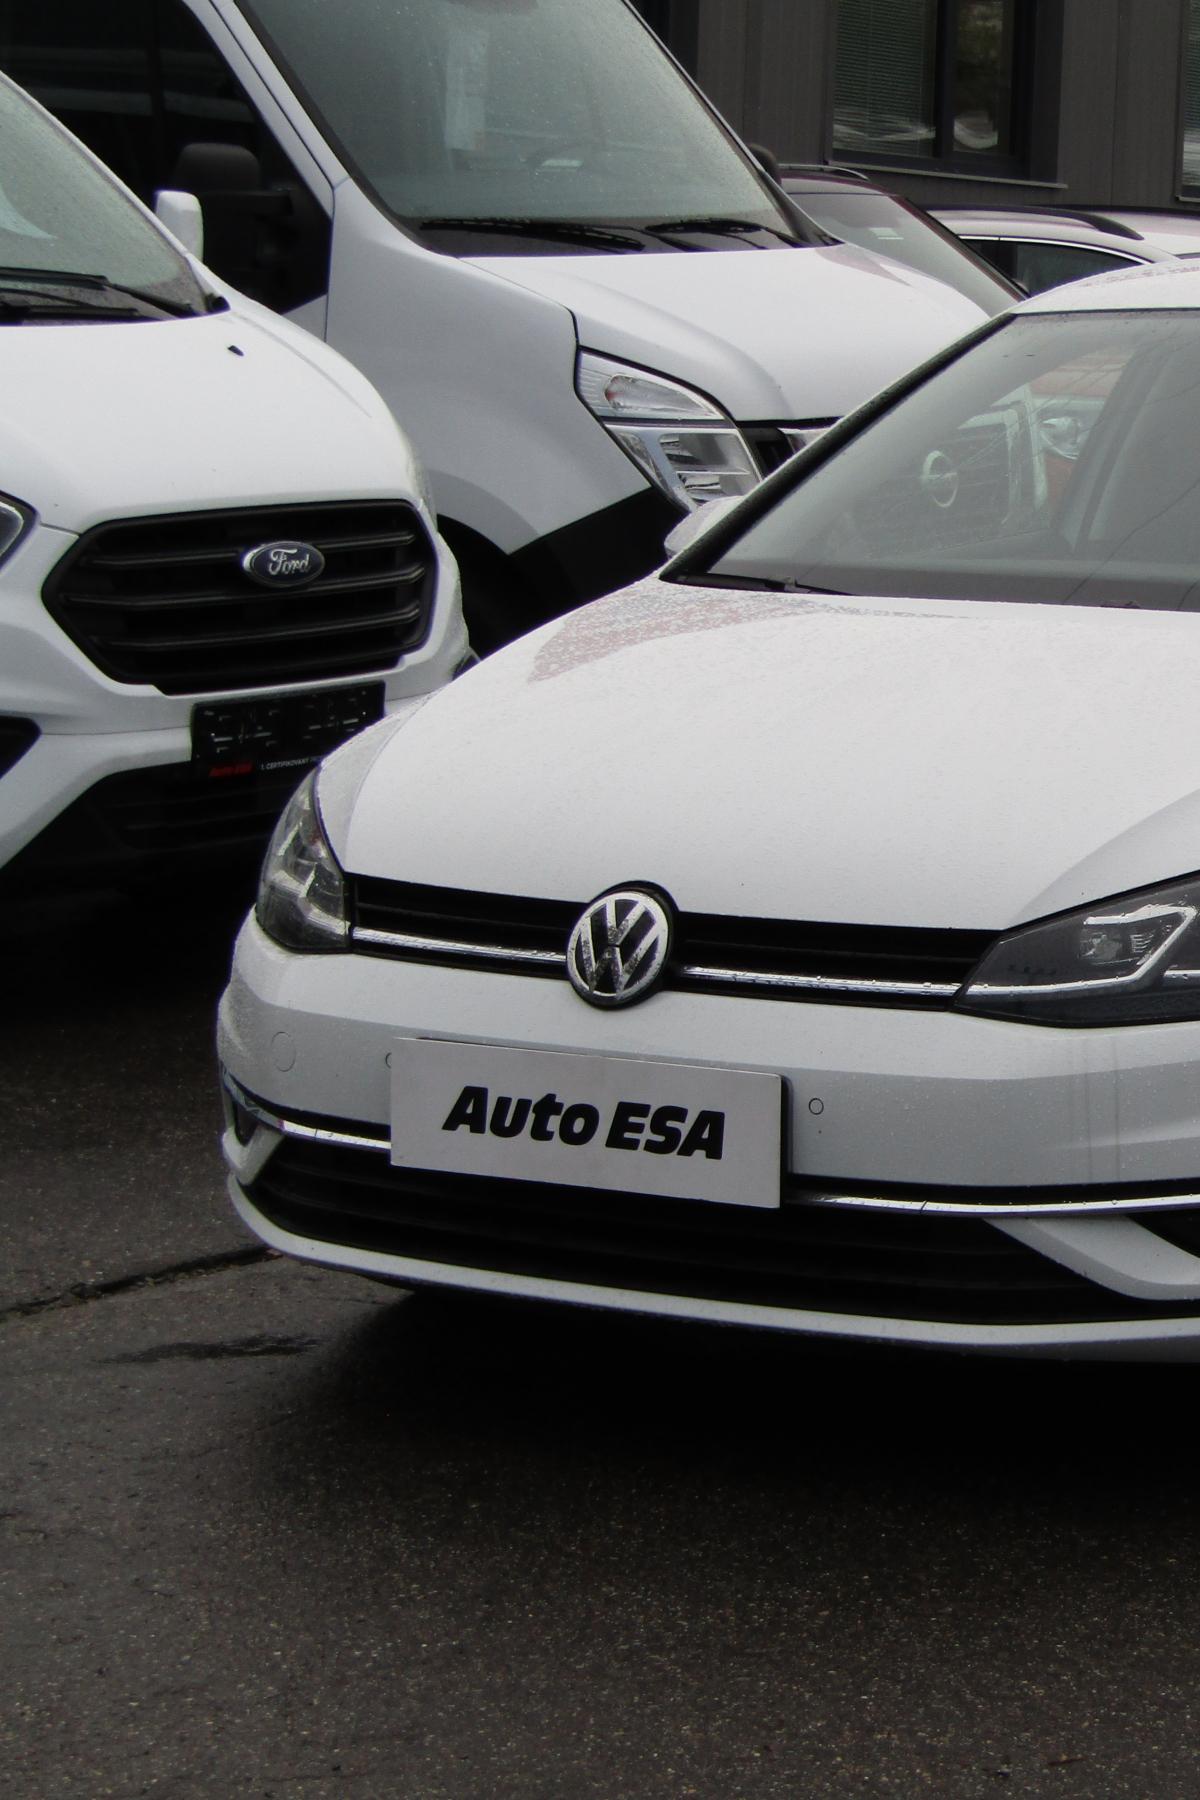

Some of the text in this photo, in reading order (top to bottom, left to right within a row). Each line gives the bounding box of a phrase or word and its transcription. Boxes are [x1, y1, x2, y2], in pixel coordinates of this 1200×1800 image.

[268, 549, 310, 576] Ford
[442, 1085, 726, 1160] Auto ESA
